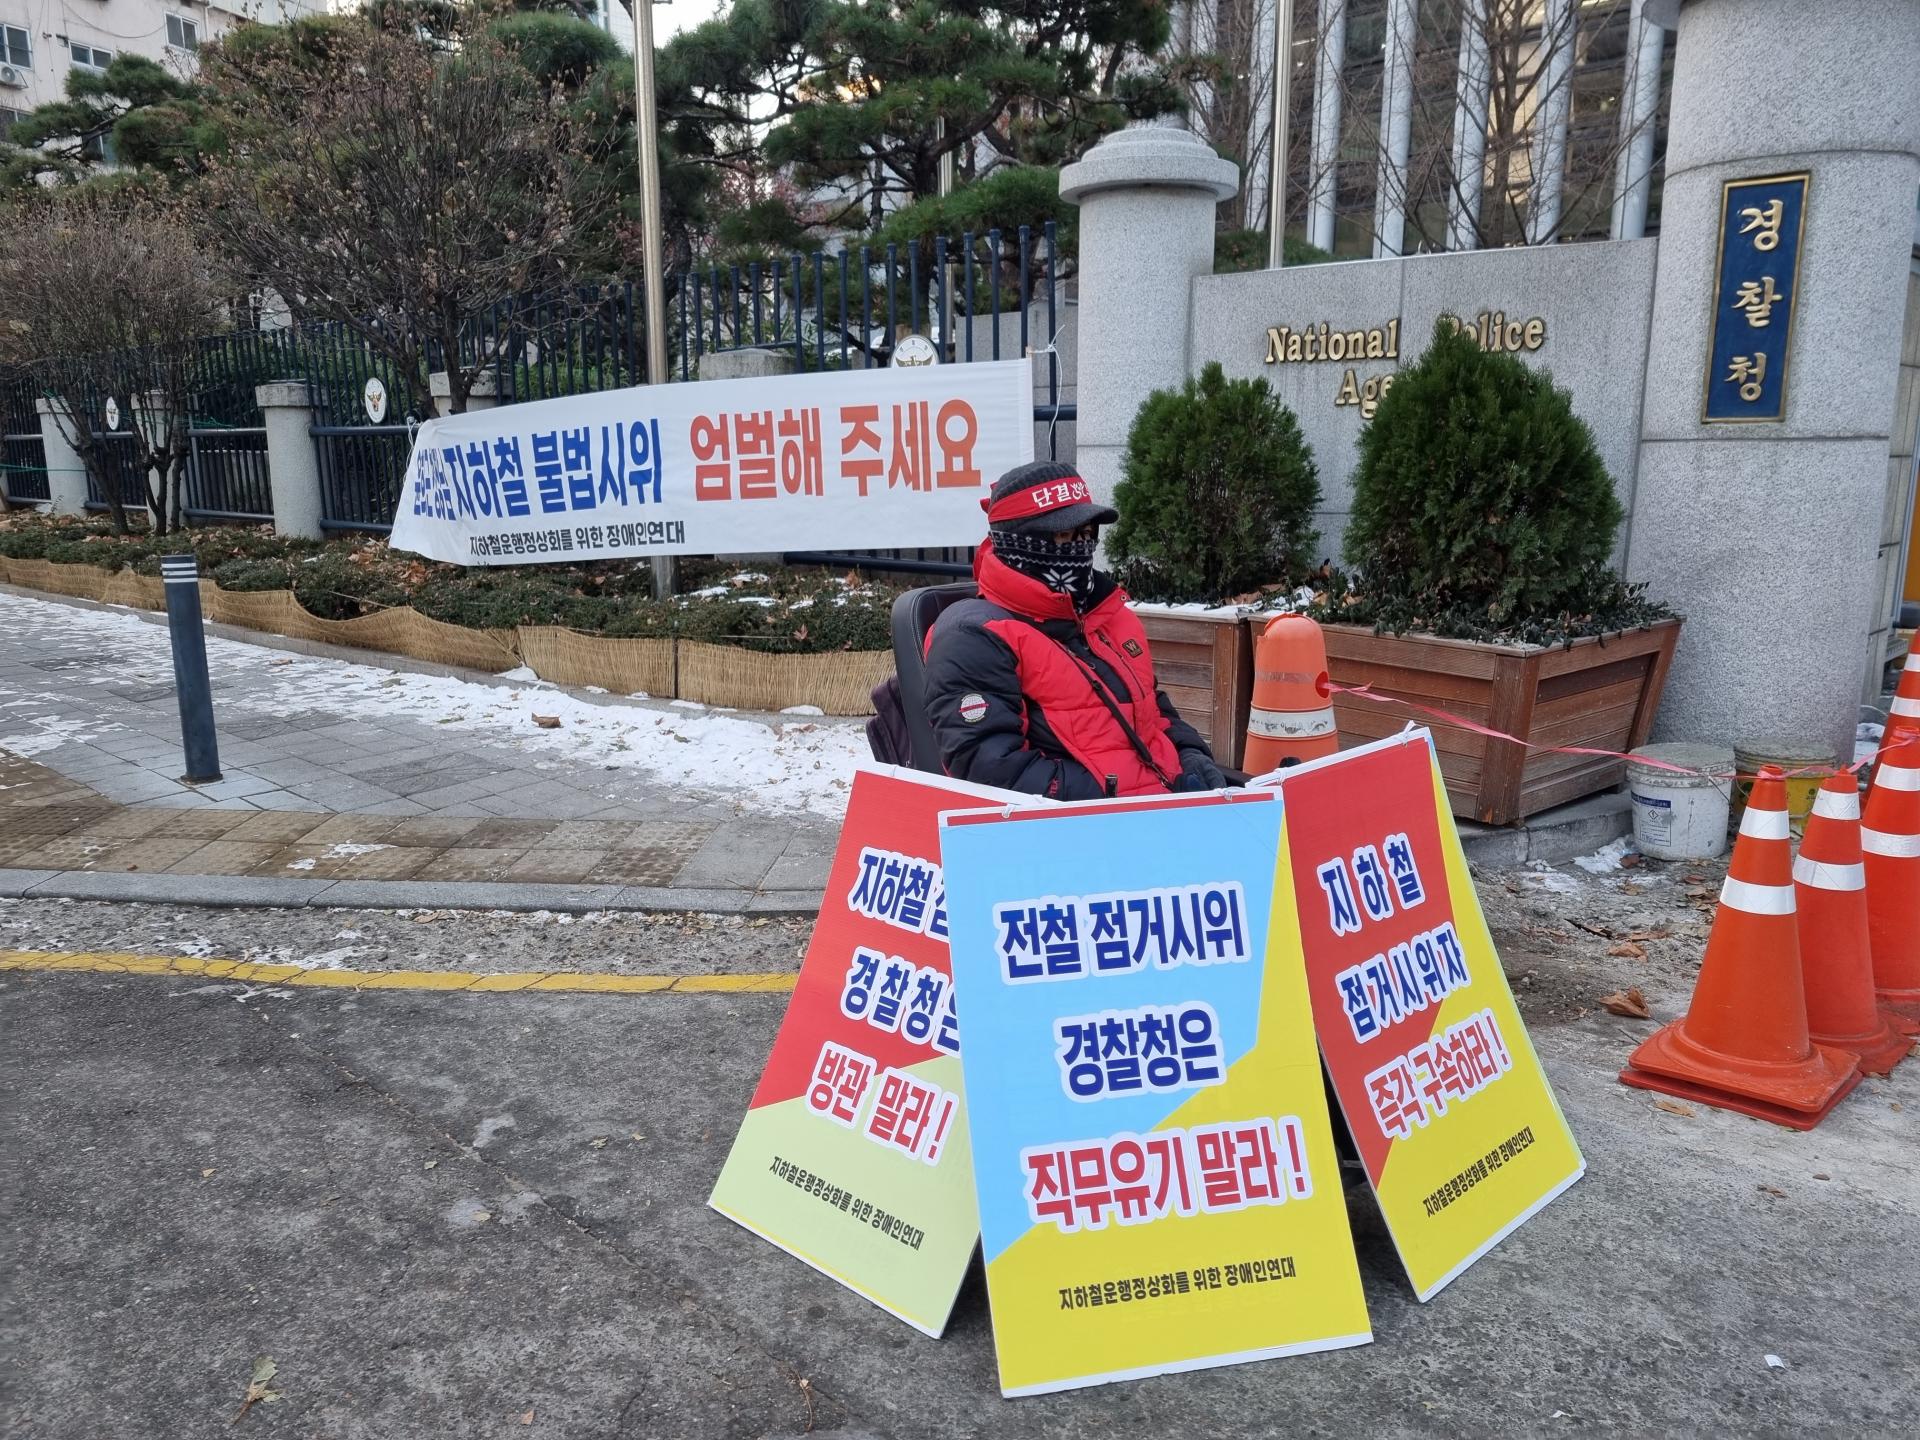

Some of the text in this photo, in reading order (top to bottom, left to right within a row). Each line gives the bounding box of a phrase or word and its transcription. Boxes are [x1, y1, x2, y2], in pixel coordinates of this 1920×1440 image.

[1265, 318, 1399, 363] National
[1724, 199, 1784, 402] 경찰청
[1335, 369, 1396, 419] Age
[443, 436, 531, 521] 지하철
[531, 418, 662, 514] 불법시위
[690, 407, 824, 501] 엄벌해
[839, 399, 982, 497] 주세요
[1032, 482, 1072, 509] 단결
[470, 520, 686, 557] 지하철운행정상화를 위한 장애인연대
[852, 853, 934, 928] 지하철
[1000, 889, 1245, 979] 전철 점거시위
[1341, 929, 1467, 1038] 점거시위자
[811, 1049, 871, 1123] 방관
[1061, 1009, 1220, 1096] 경찰청은
[1369, 1065, 1424, 1133] 즉각
[769, 1156, 925, 1251] 지하철운행정상화를 위한 장애인연대
[1028, 1136, 1192, 1227] 직무유기
[1422, 1125, 1536, 1218] 지하철운행정상화를 위한 장애인연대
[1059, 1256, 1297, 1310] 지하철운행정상화를 위한 장애인연대
